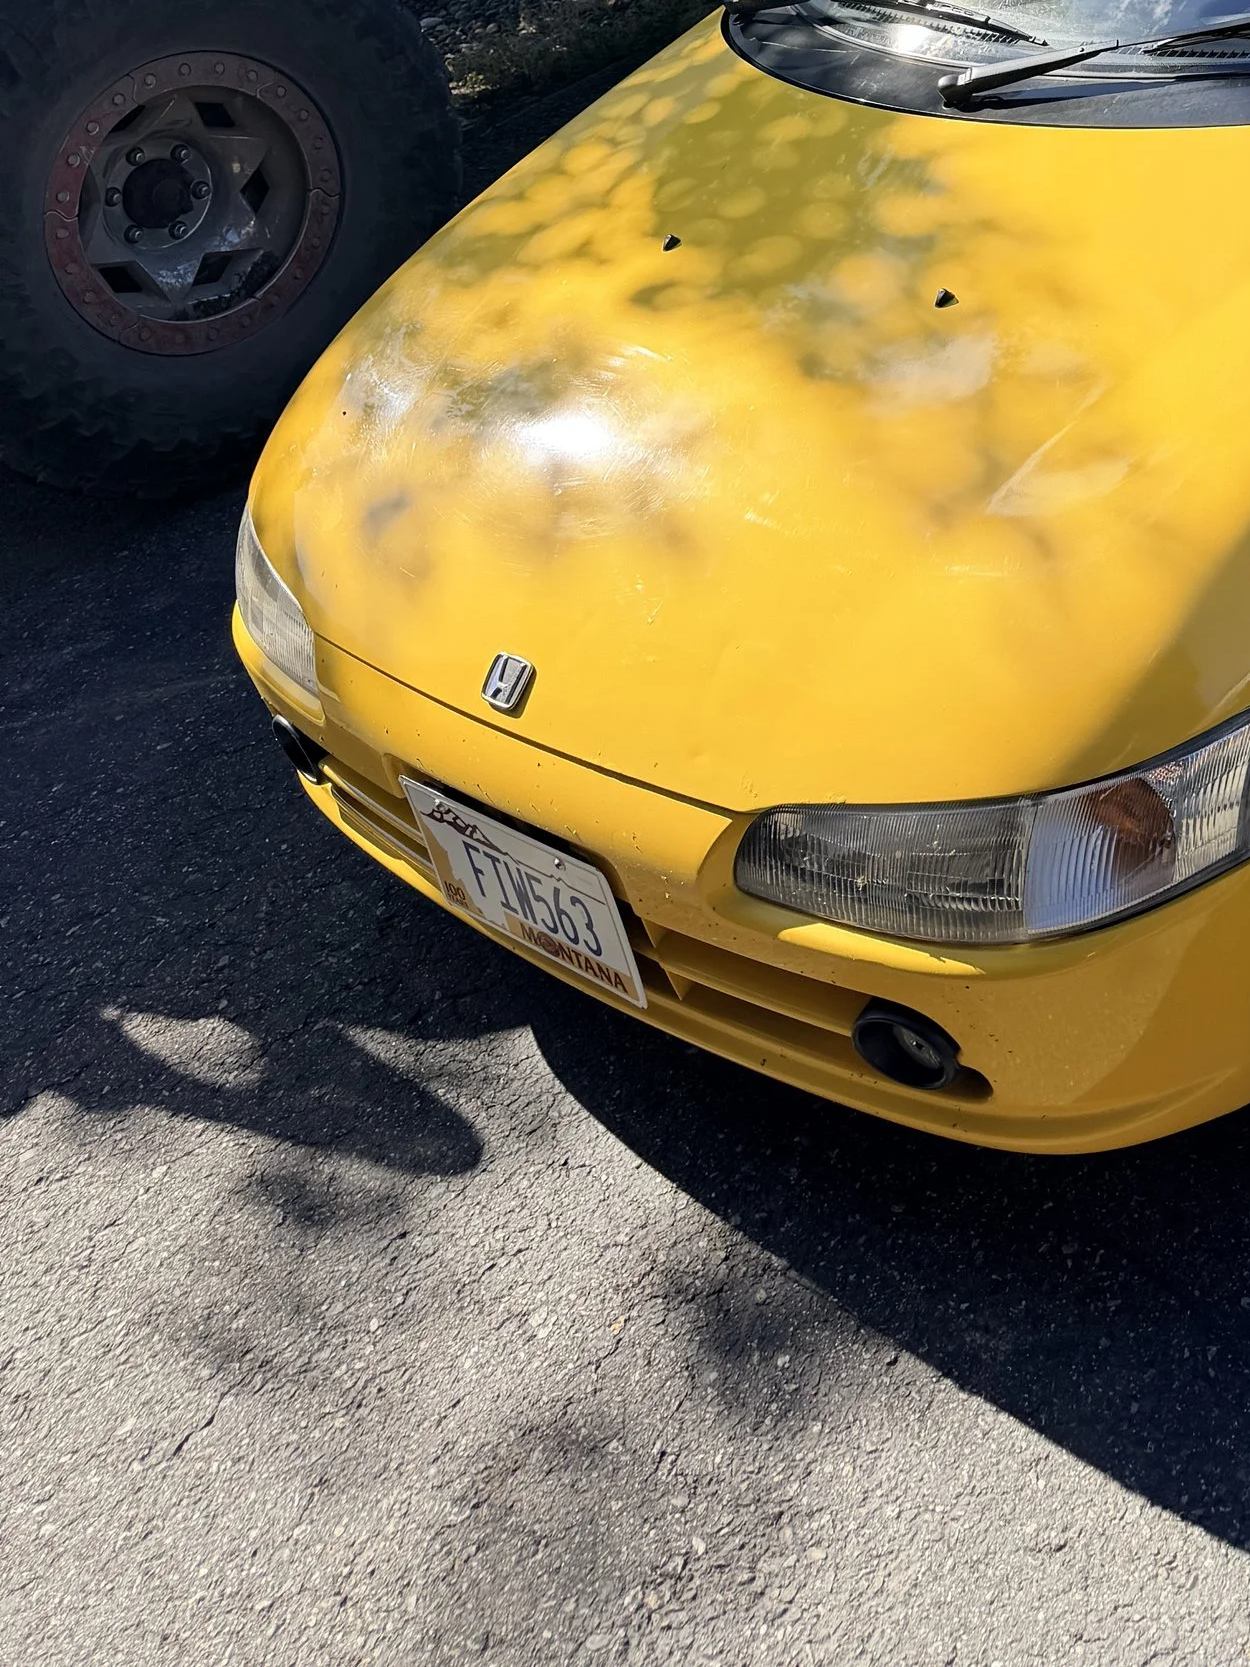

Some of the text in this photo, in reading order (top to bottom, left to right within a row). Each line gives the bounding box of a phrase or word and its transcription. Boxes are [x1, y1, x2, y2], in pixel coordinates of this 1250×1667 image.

[443, 880, 466, 901] 100
[462, 840, 602, 957] FIW563
[519, 922, 629, 994] MONTANA
